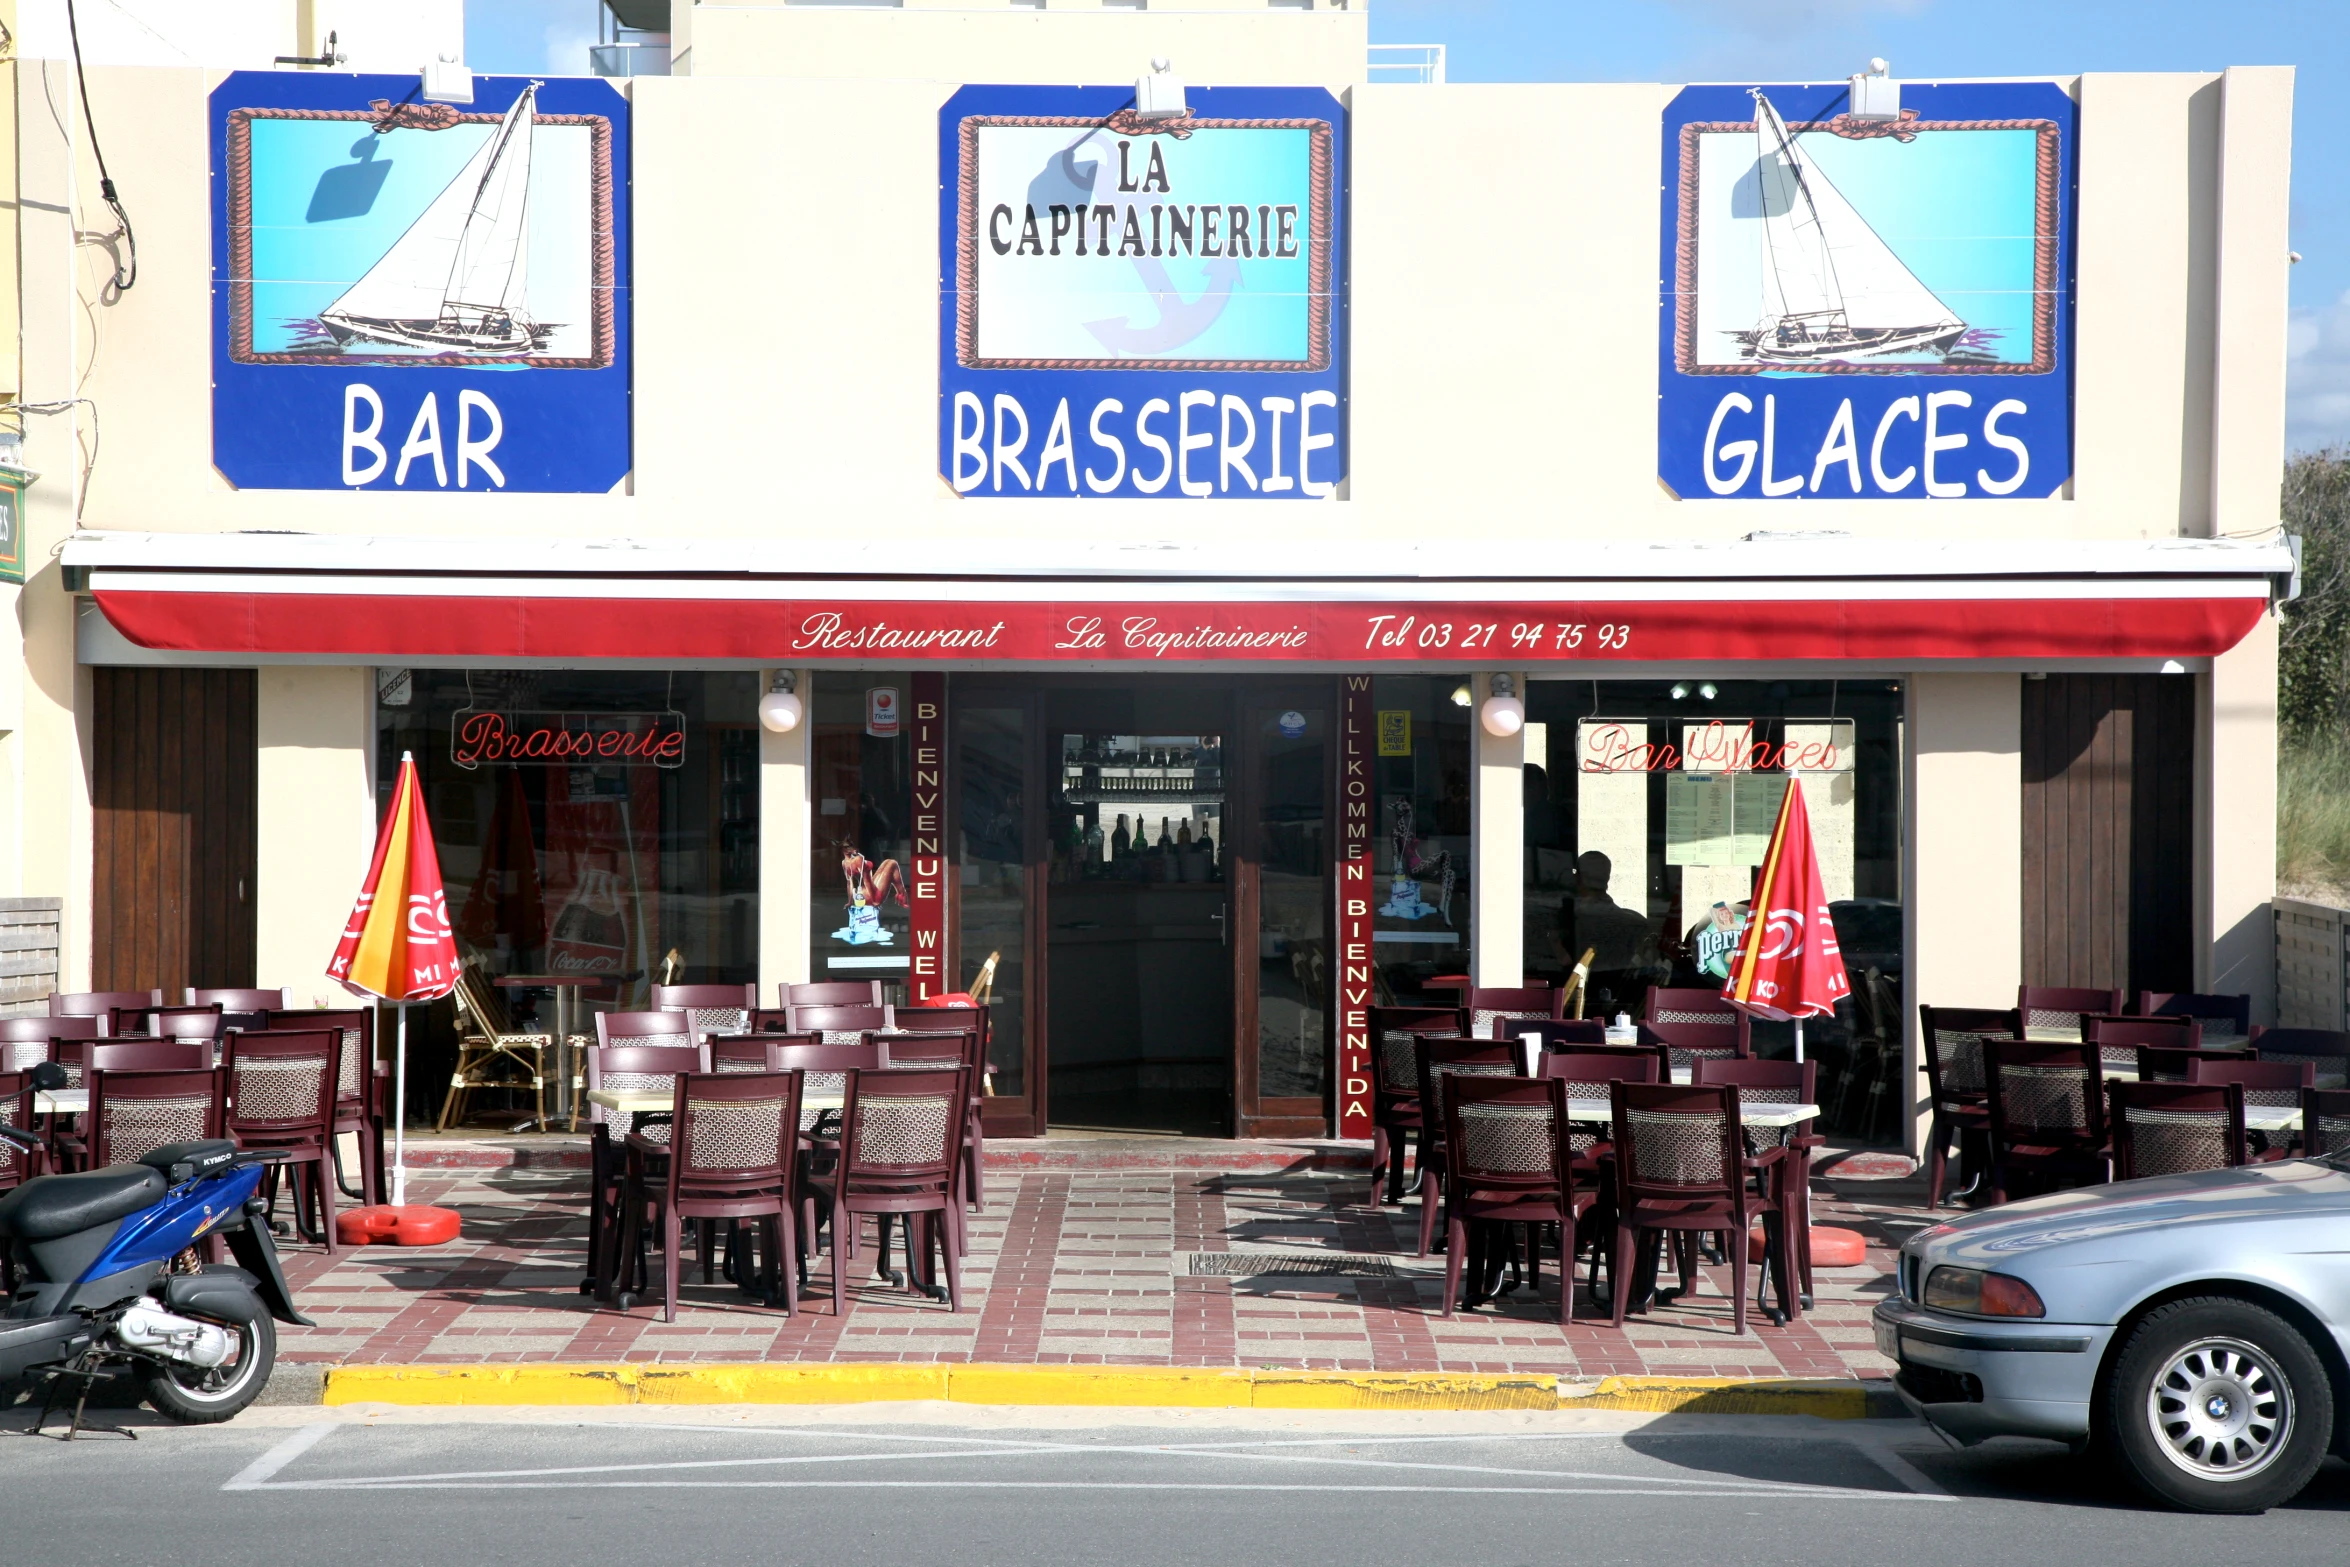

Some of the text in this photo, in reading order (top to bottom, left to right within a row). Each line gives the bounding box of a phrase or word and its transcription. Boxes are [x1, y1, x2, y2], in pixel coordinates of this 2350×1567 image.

[1116, 140, 1171, 193] LA
[989, 203, 1300, 259] CAPITAINERIE
[342, 383, 506, 488] BAR
[952, 390, 1337, 497] BRASSERIE
[1703, 390, 2030, 497] GLACES
[791, 611, 1630, 657] Restaurant La Capitainerie Tel 03 21 94 75 93
[381, 669, 412, 700] LICENCE
[457, 713, 684, 762] Brasserie
[1584, 723, 1682, 773] Bar
[1687, 720, 1837, 775] Glaces
[916, 703, 938, 899] BIENVENUE
[1345, 676, 1370, 1118] WILLKOMMEN BIENVENIDA
[203, 1153, 232, 1166] KYMCO
